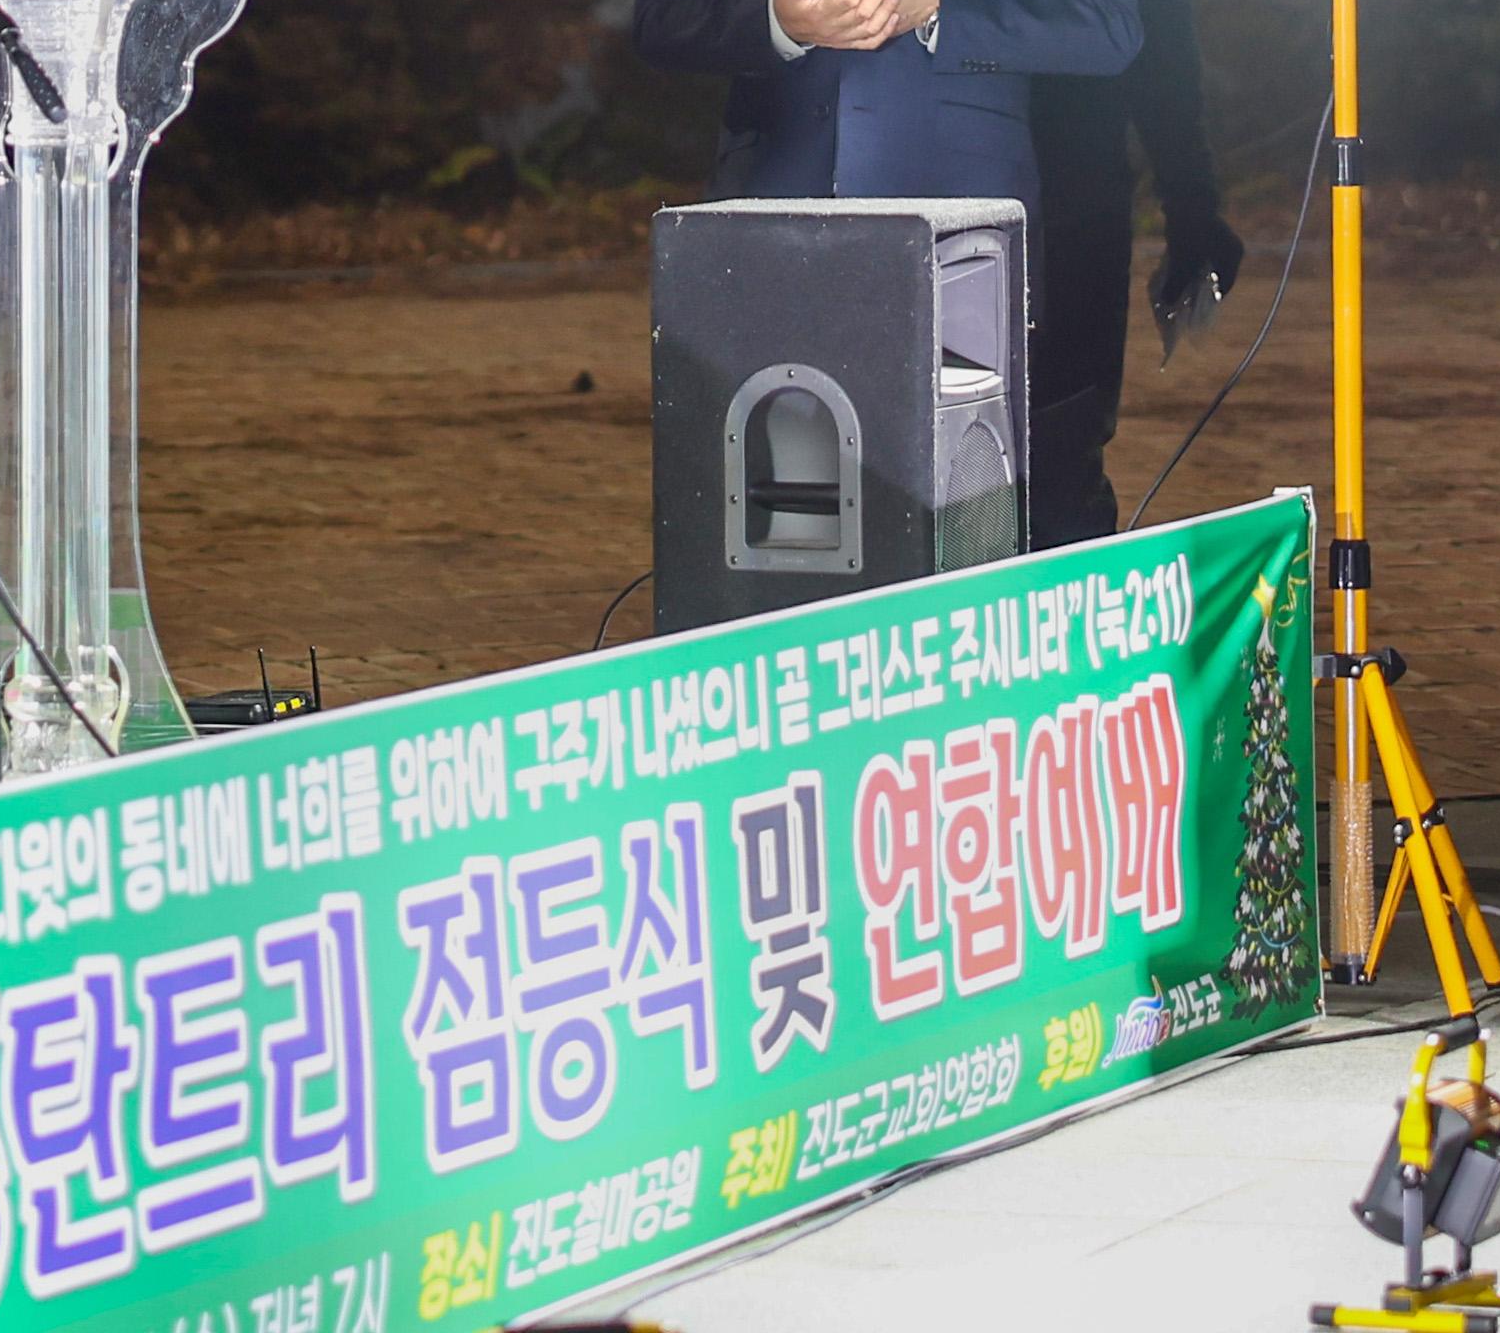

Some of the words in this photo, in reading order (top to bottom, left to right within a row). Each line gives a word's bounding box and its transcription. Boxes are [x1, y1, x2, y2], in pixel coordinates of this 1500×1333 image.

[120, 775, 253, 913] 동네에
[257, 744, 383, 871] 너희를
[389, 716, 508, 843] 위하여
[513, 689, 625, 811] 구주가
[630, 654, 770, 779] 나셨으니
[776, 645, 811, 746] 곧
[815, 617, 945, 732] 그리스도
[398, 802, 717, 1175] 점등식
[733, 770, 837, 1073] 및
[854, 674, 1186, 1022] 연합예배
[1168, 973, 1222, 1038] 진도군
[506, 1145, 701, 1289] 진도철마공원
[796, 1033, 1021, 1180] 진도군교회연합회
